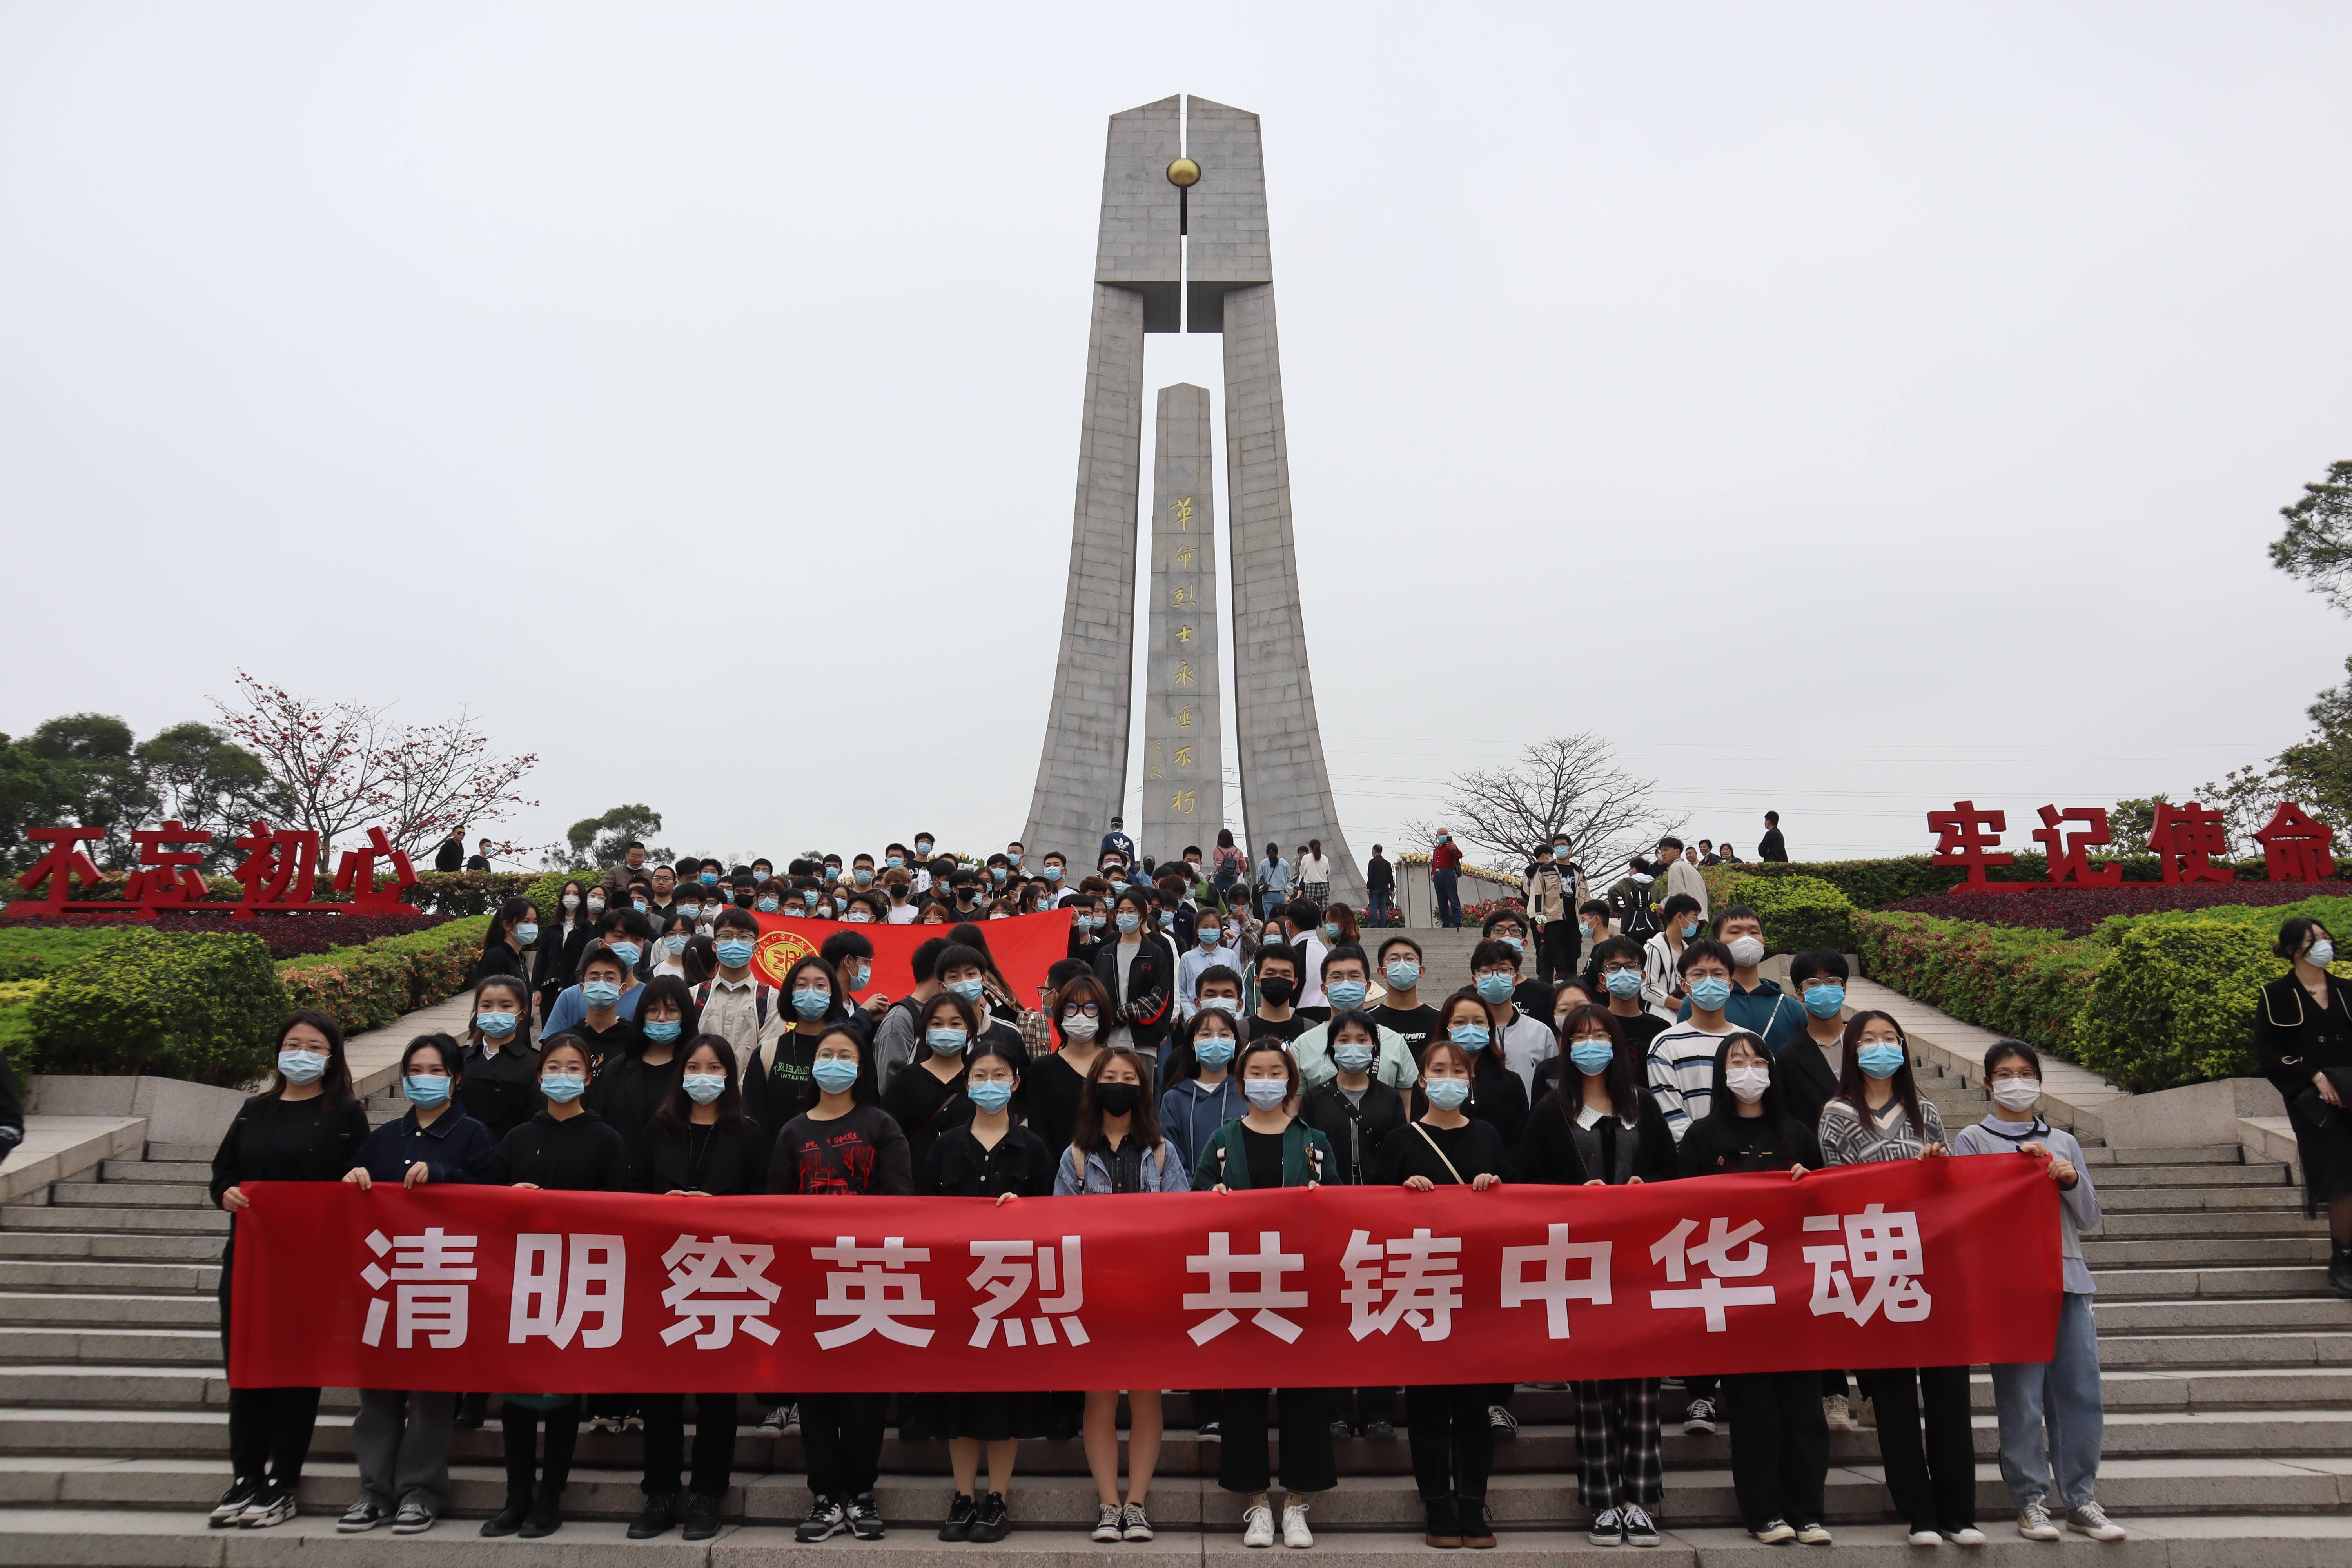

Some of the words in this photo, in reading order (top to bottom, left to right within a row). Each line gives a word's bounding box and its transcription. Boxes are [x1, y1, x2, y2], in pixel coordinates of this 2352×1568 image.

[1169, 495, 1198, 814] 革命烈士永垂不朽
[17, 820, 420, 903] 不忘初心
[1927, 800, 2335, 884] 牢记使命
[773, 1062, 810, 1075] TREAS
[780, 1073, 810, 1082] INTERNA
[361, 1227, 1091, 1350] 清明祭英烈
[1183, 1203, 1932, 1346] 共铸中华魂
